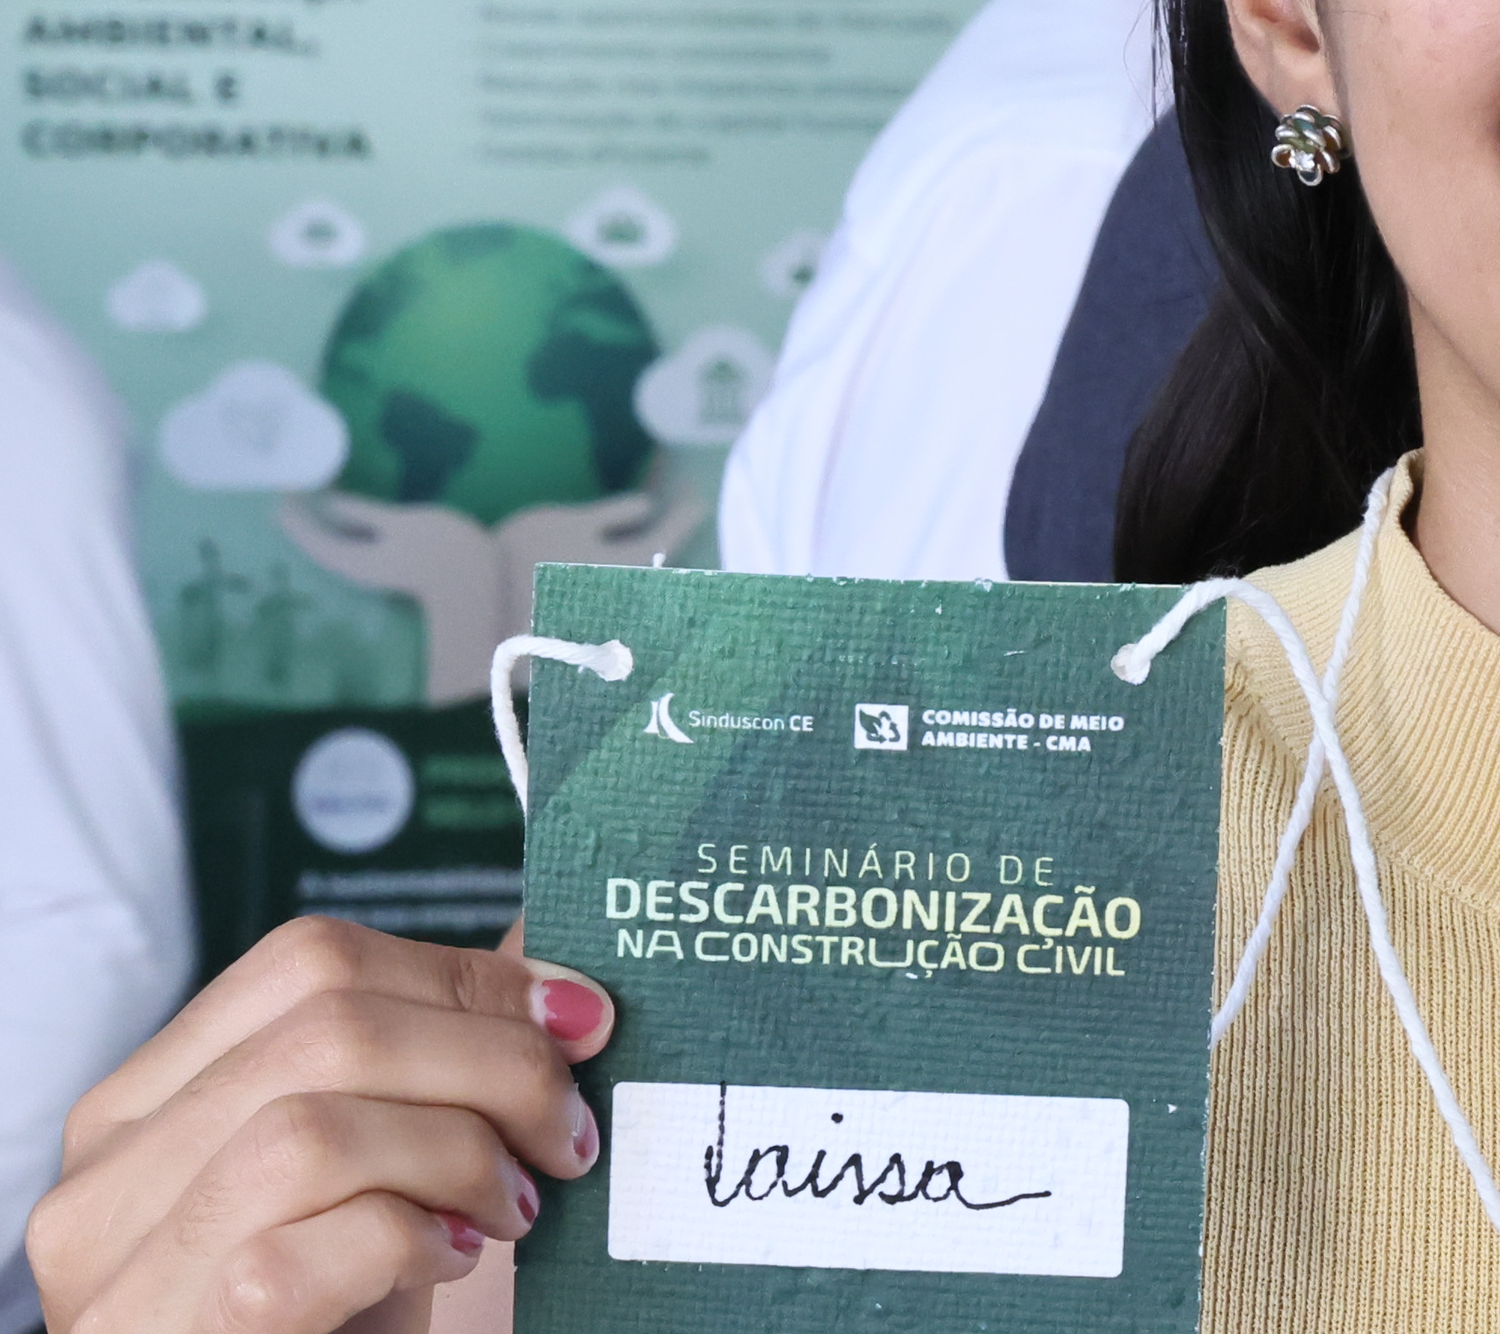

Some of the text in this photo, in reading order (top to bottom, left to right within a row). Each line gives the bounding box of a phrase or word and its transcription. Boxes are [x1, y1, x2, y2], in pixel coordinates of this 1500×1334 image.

[688, 709, 814, 733] Sinduscon CE
[922, 708, 1125, 732] COMISSÃO DE MEIO
[921, 731, 1028, 751] AMBIENTE
[1046, 735, 1091, 753] CMA
[697, 842, 1055, 887] SEMINÁRIO DE
[605, 877, 1142, 950] DESCARBONIZAÇÃO
[616, 928, 1126, 978] NA CONSTRUÇÃO CIVIL
